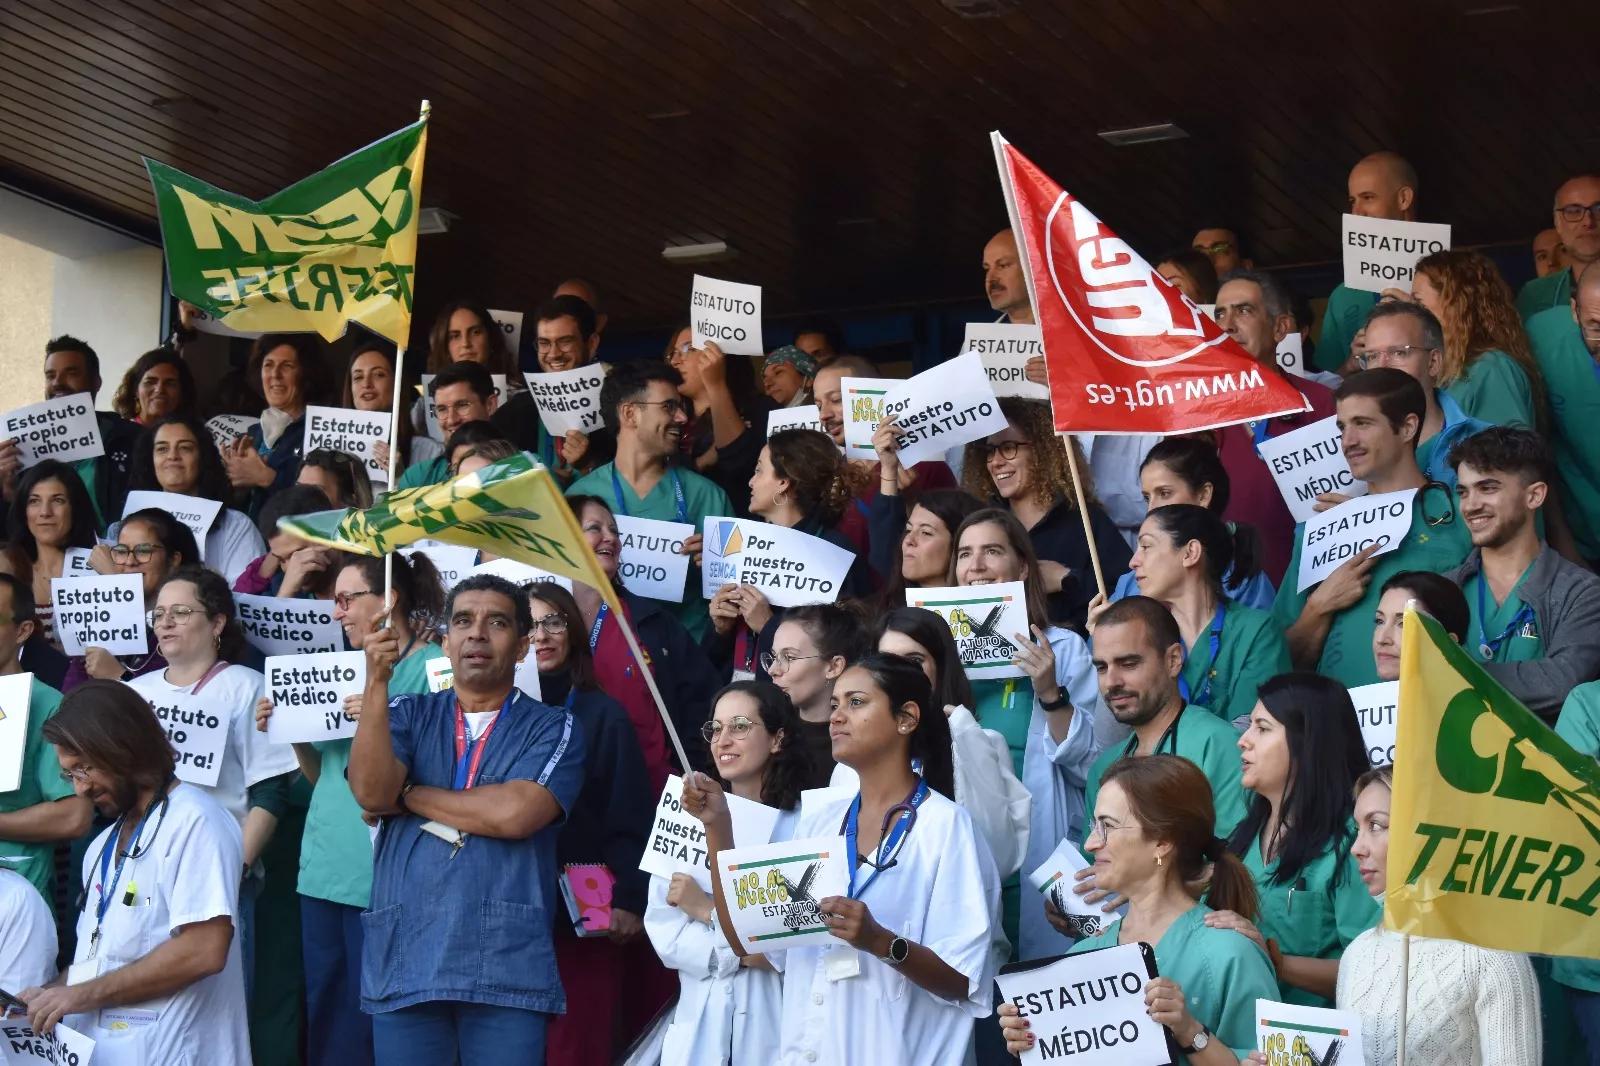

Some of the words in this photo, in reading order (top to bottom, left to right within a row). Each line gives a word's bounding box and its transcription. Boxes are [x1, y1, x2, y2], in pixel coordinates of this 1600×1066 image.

[1348, 231, 1444, 254] ESTATUTO
[1360, 261, 1416, 282] PROPI
[693, 291, 755, 315] ESTATUTO
[697, 319, 747, 341] MÉDICO
[984, 367, 1030, 381] ROPI
[530, 377, 601, 396] Estatuto
[1086, 369, 1265, 412] www.ugt.es
[537, 397, 591, 412] Médico
[853, 409, 885, 422] NUEV
[886, 398, 911, 417] Por
[7, 405, 86, 432] Estatuto
[311, 416, 383, 436] Estatuto
[896, 402, 992, 450] ESTATUTO
[32, 431, 96, 459] ¡ahora!
[309, 432, 366, 452] Médico
[1272, 435, 1342, 475] ESTATU
[1294, 470, 1354, 502] MÉDIC
[1306, 501, 1405, 546] ESTATUTO
[618, 532, 685, 555] ATUTO
[747, 535, 775, 551] Por
[1311, 534, 1391, 569] MÉDICO
[618, 562, 666, 581] OPIO
[709, 562, 737, 579] SEMCA
[743, 555, 805, 572] nuestro
[741, 571, 833, 594] ESTATUTO
[58, 587, 135, 606] Estatuto
[60, 606, 111, 629] propio
[239, 603, 331, 625] Estatuto
[75, 624, 139, 646] ¡ahora!
[241, 620, 314, 641] Médico
[955, 636, 1000, 649] ATUTO
[272, 664, 356, 687] Estatuto
[272, 686, 337, 707] Médico
[150, 700, 219, 729] atuto
[173, 751, 214, 770] ora!
[657, 817, 707, 843] nuestr
[652, 834, 711, 870] ESTAT
[767, 868, 785, 888] AL
[737, 884, 788, 910] NUEVO
[762, 900, 816, 918] ESTATUTO
[1012, 971, 1142, 1018] ESTATUTO
[1038, 1020, 1139, 1061] MÉDICO
[1292, 1035, 1310, 1056] AL
